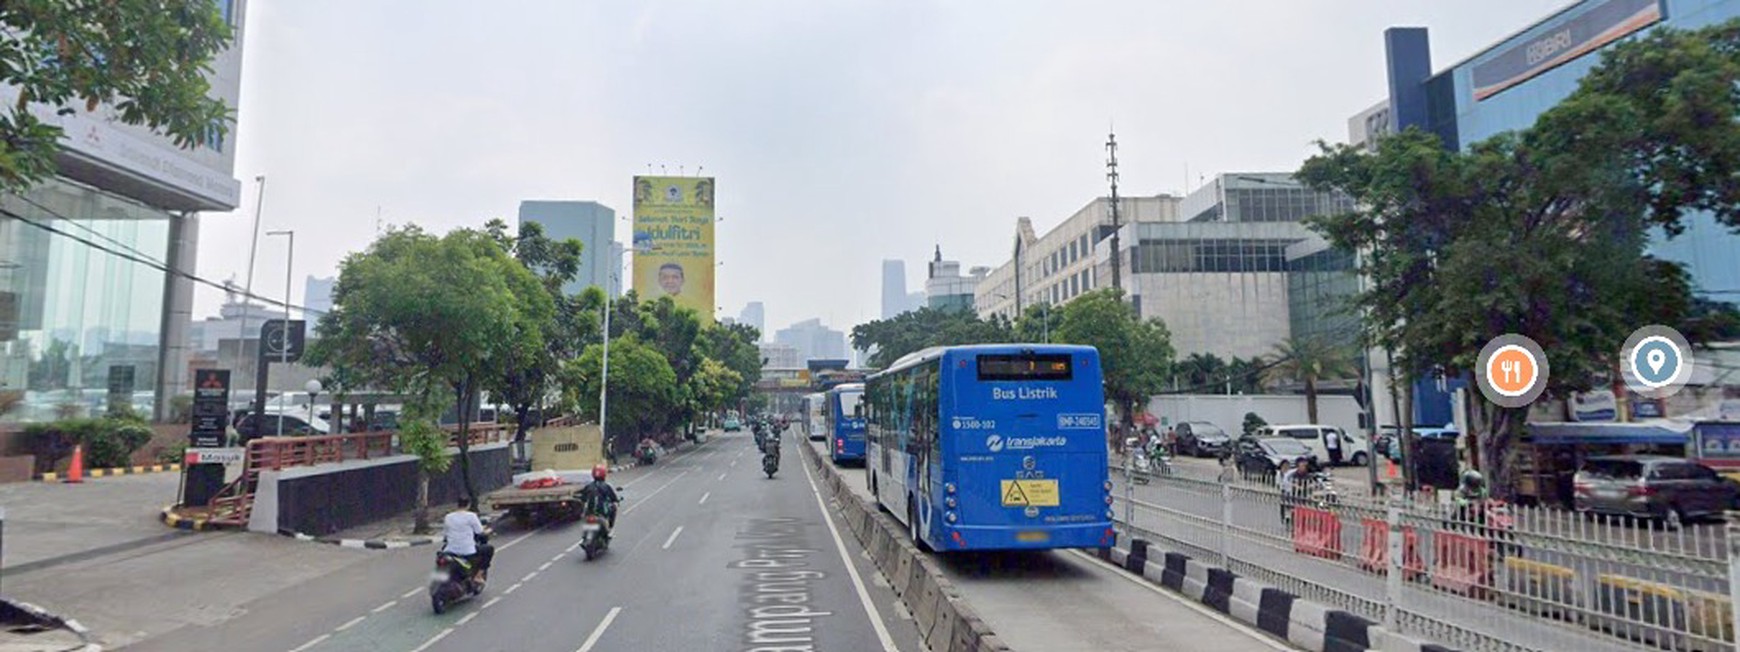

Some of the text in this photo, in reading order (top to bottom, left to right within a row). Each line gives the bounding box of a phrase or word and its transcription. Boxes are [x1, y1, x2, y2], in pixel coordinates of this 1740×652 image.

[993, 387, 1058, 399] Bus Listrik
[1006, 436, 1067, 449] transjakarta
